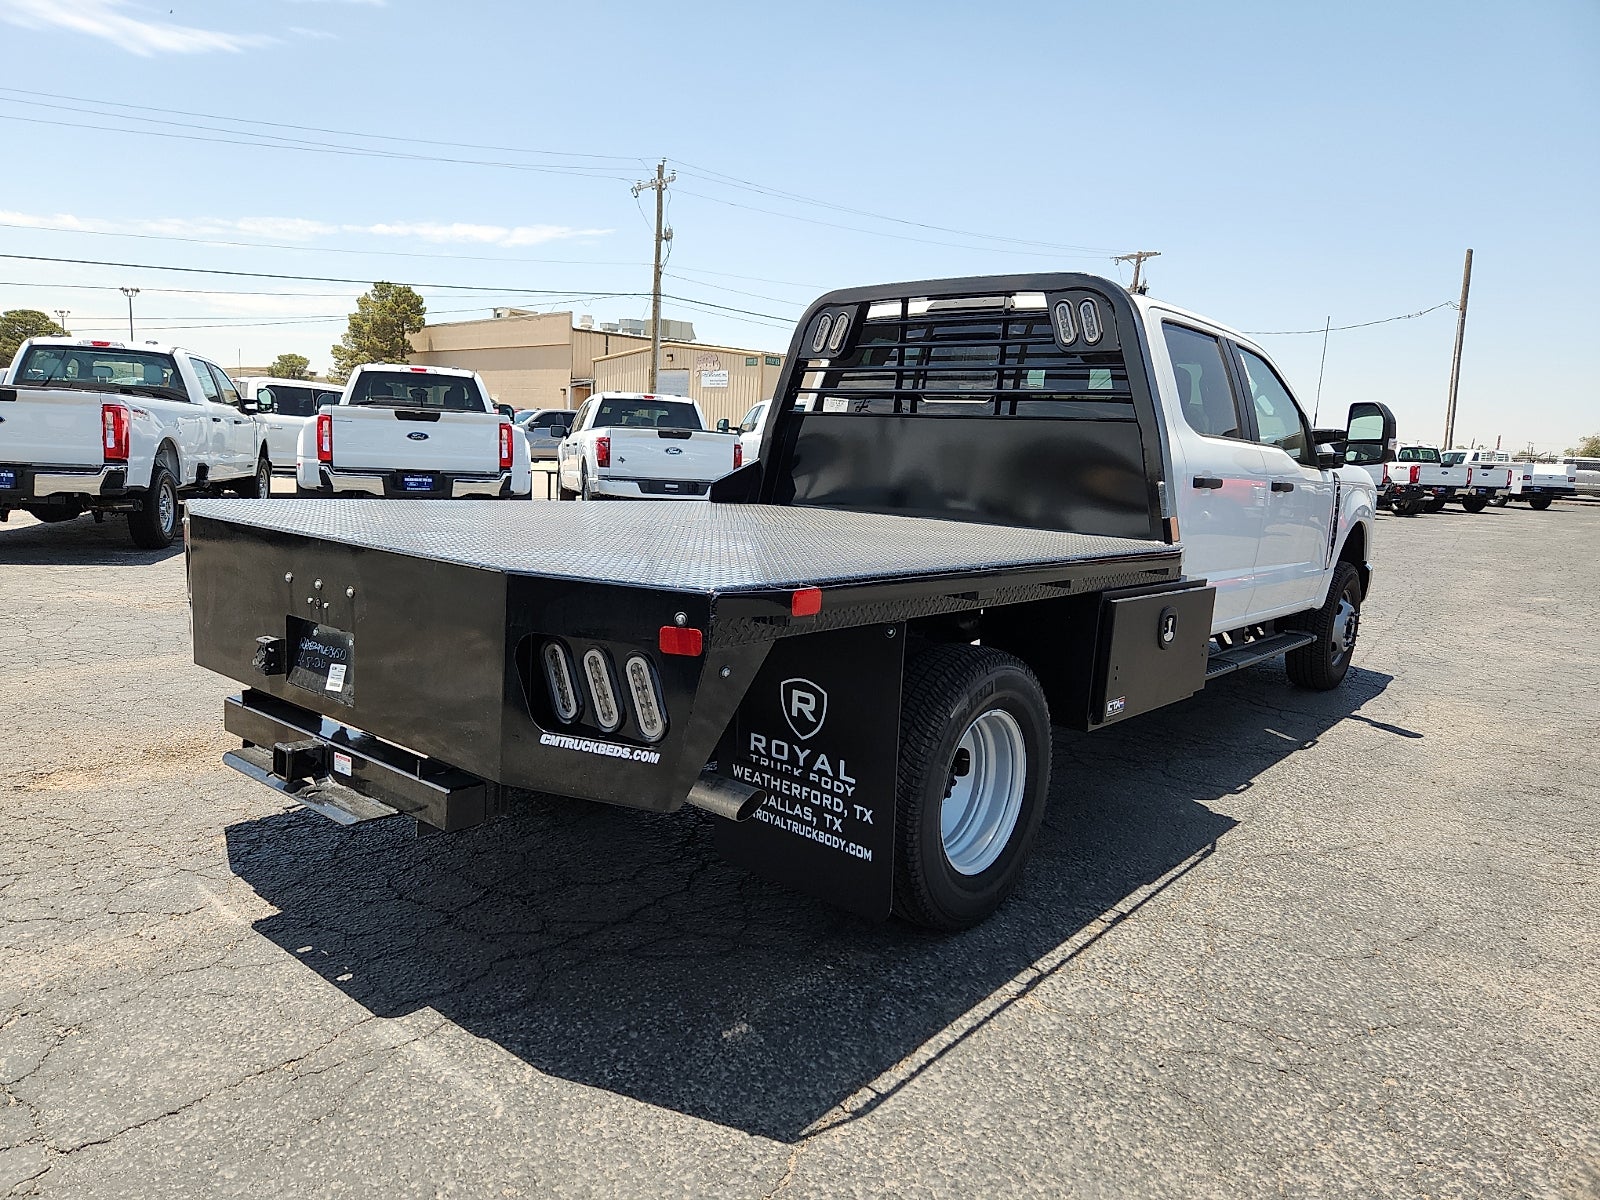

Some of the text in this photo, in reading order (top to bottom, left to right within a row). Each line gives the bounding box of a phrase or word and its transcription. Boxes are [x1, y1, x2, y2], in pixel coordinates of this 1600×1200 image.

[791, 689, 817, 723] R
[539, 733, 661, 765] CMTRUCKBEDS.COM
[750, 732, 856, 784] ROYAL
[732, 763, 874, 825] WEATHERFORD, TX
[823, 813, 843, 833] TX
